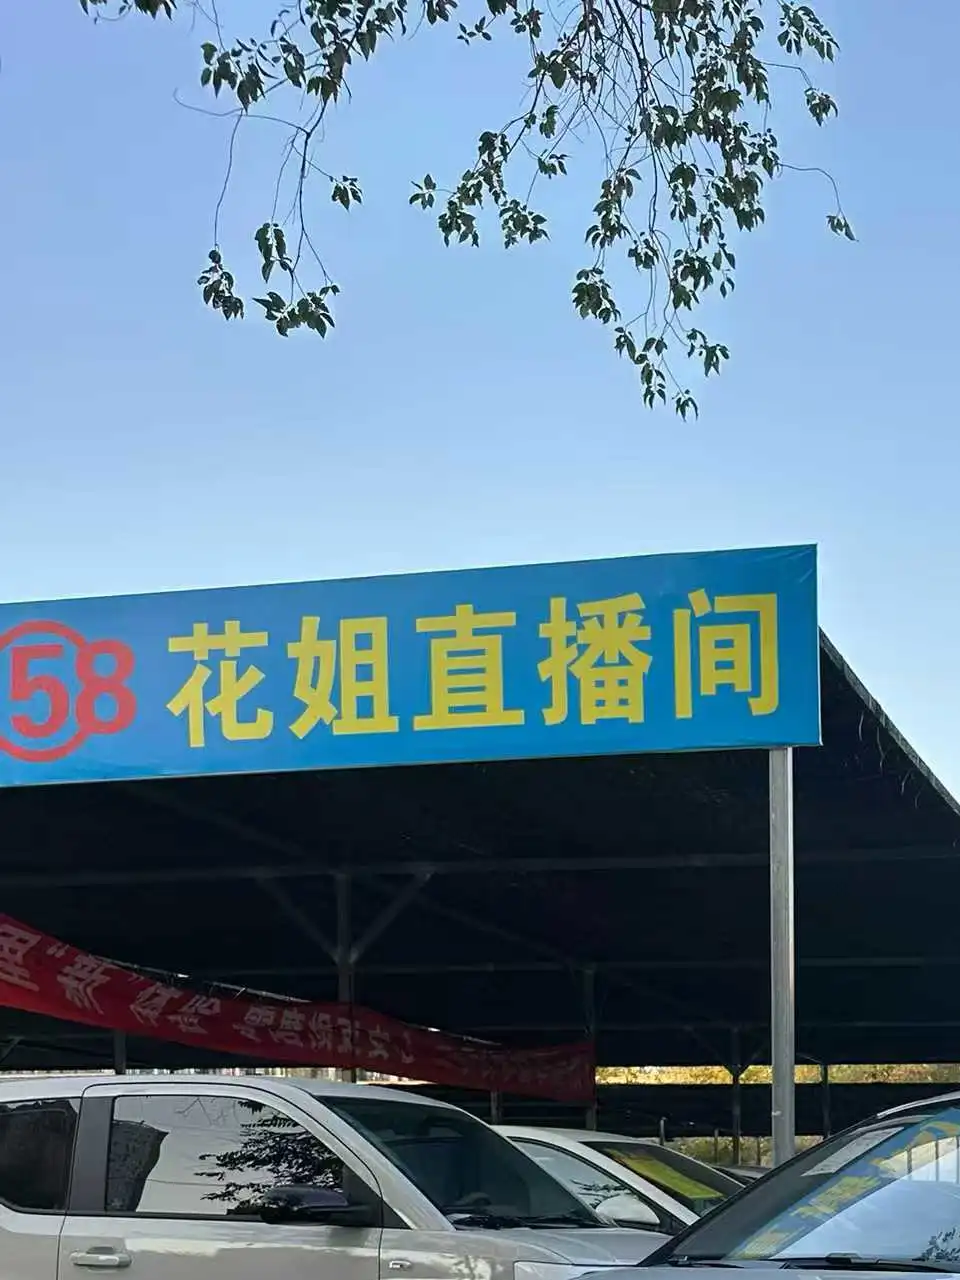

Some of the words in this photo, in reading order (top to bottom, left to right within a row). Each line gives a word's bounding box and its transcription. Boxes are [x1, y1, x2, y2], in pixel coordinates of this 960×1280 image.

[9, 639, 137, 738] 58
[166, 588, 778, 747] 花姐直播间
